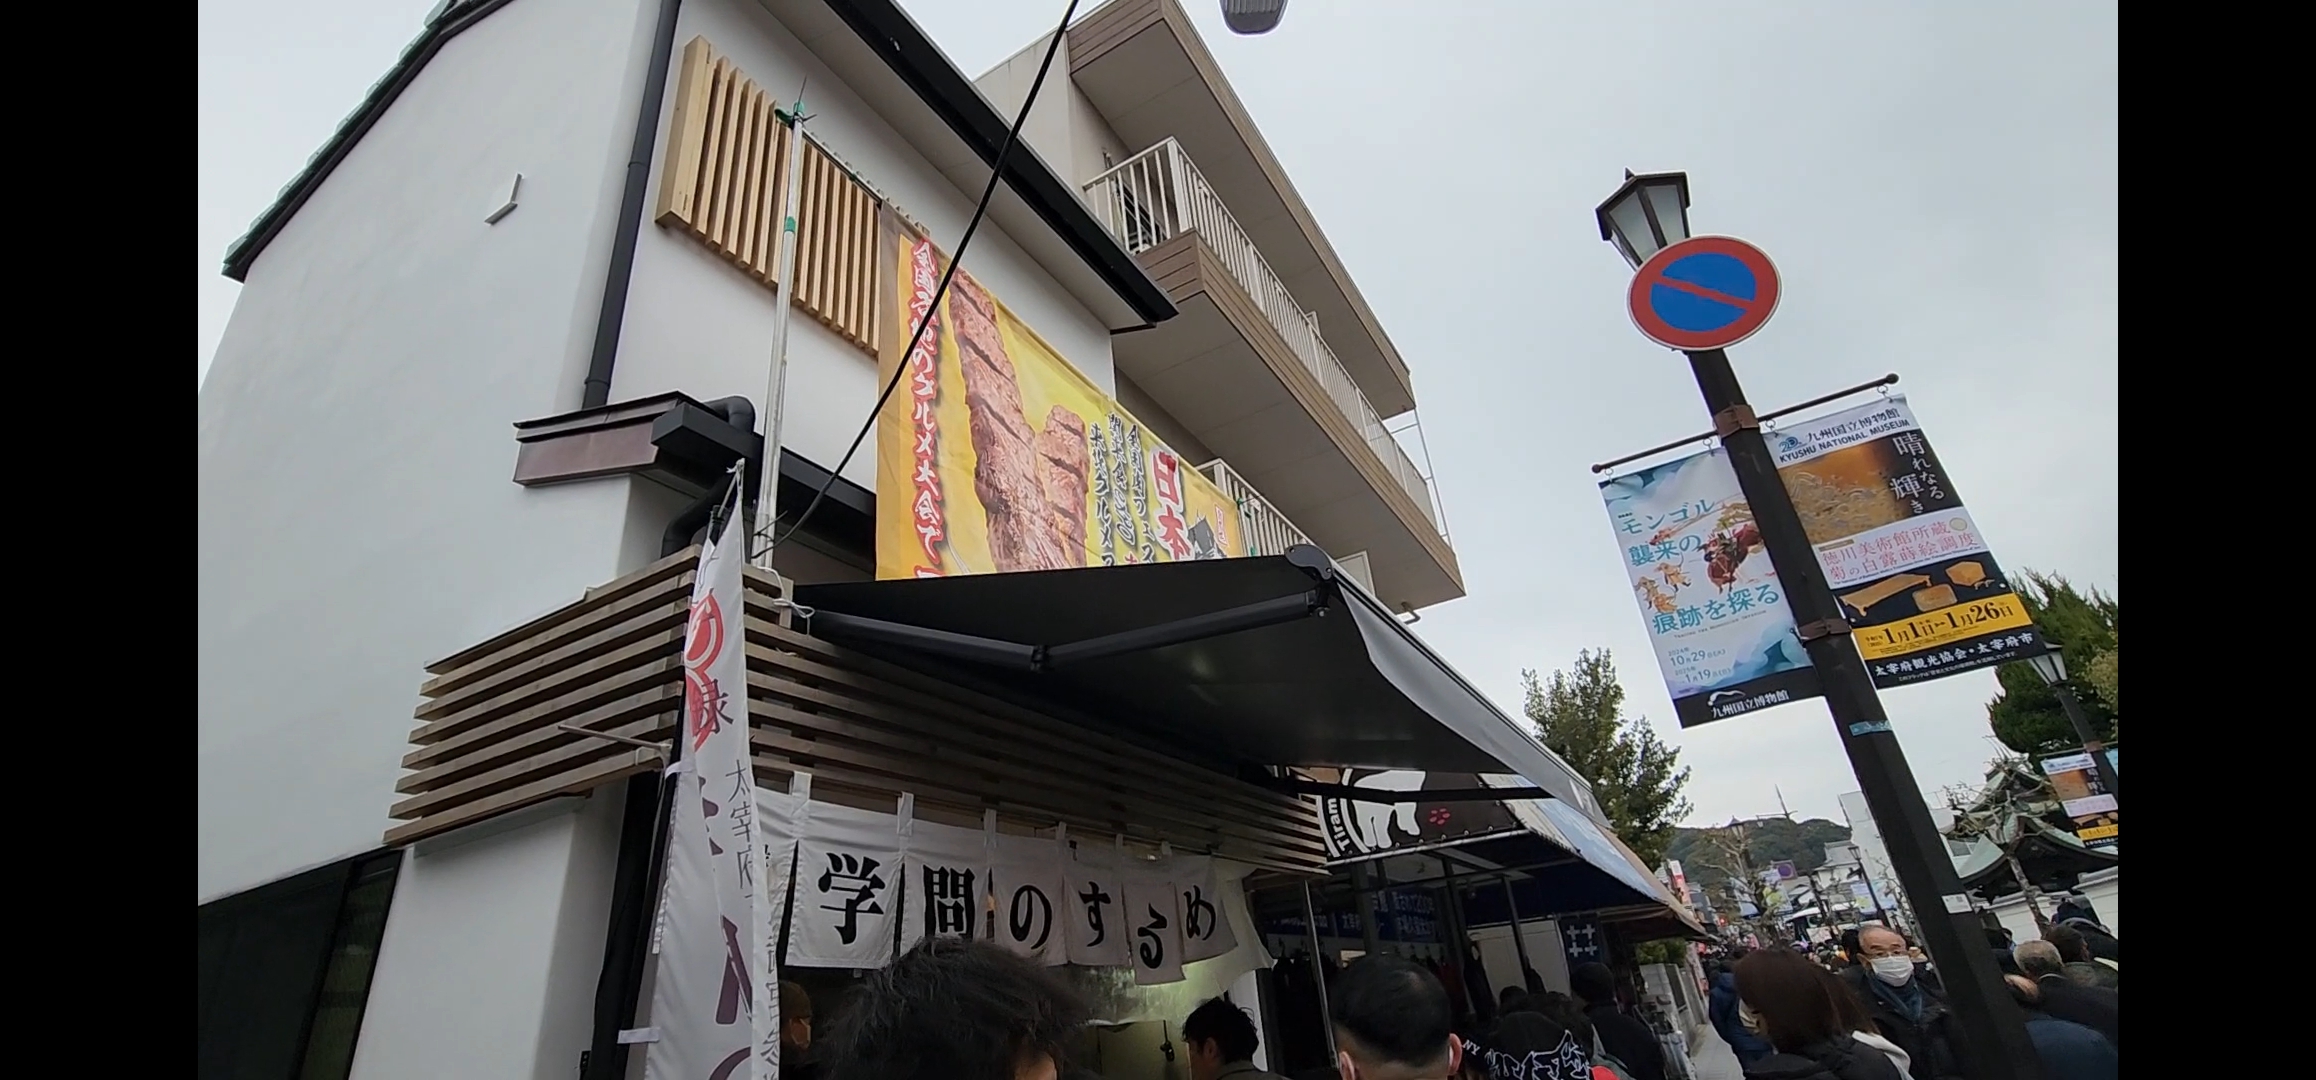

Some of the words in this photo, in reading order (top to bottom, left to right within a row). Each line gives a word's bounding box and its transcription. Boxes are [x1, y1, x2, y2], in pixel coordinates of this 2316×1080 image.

[1779, 445, 1817, 464] KYUSHU
[1819, 432, 1869, 454] NATIONAL
[1870, 419, 1911, 439] MUSEUM
[1806, 407, 1900, 443] 九州国立博物館
[1893, 432, 1944, 500] 晴れなる
[1889, 473, 1925, 514] 輝き
[1621, 499, 1715, 536] モンゴル
[1628, 534, 1702, 567] 襲来の
[1823, 521, 1951, 566] 徳川美術館所蔵
[1829, 532, 1979, 580] 菊の白露蒔絵調度
[1653, 583, 1780, 635] 痕跡を探る
[1711, 689, 1790, 719] 九州国立博物館
